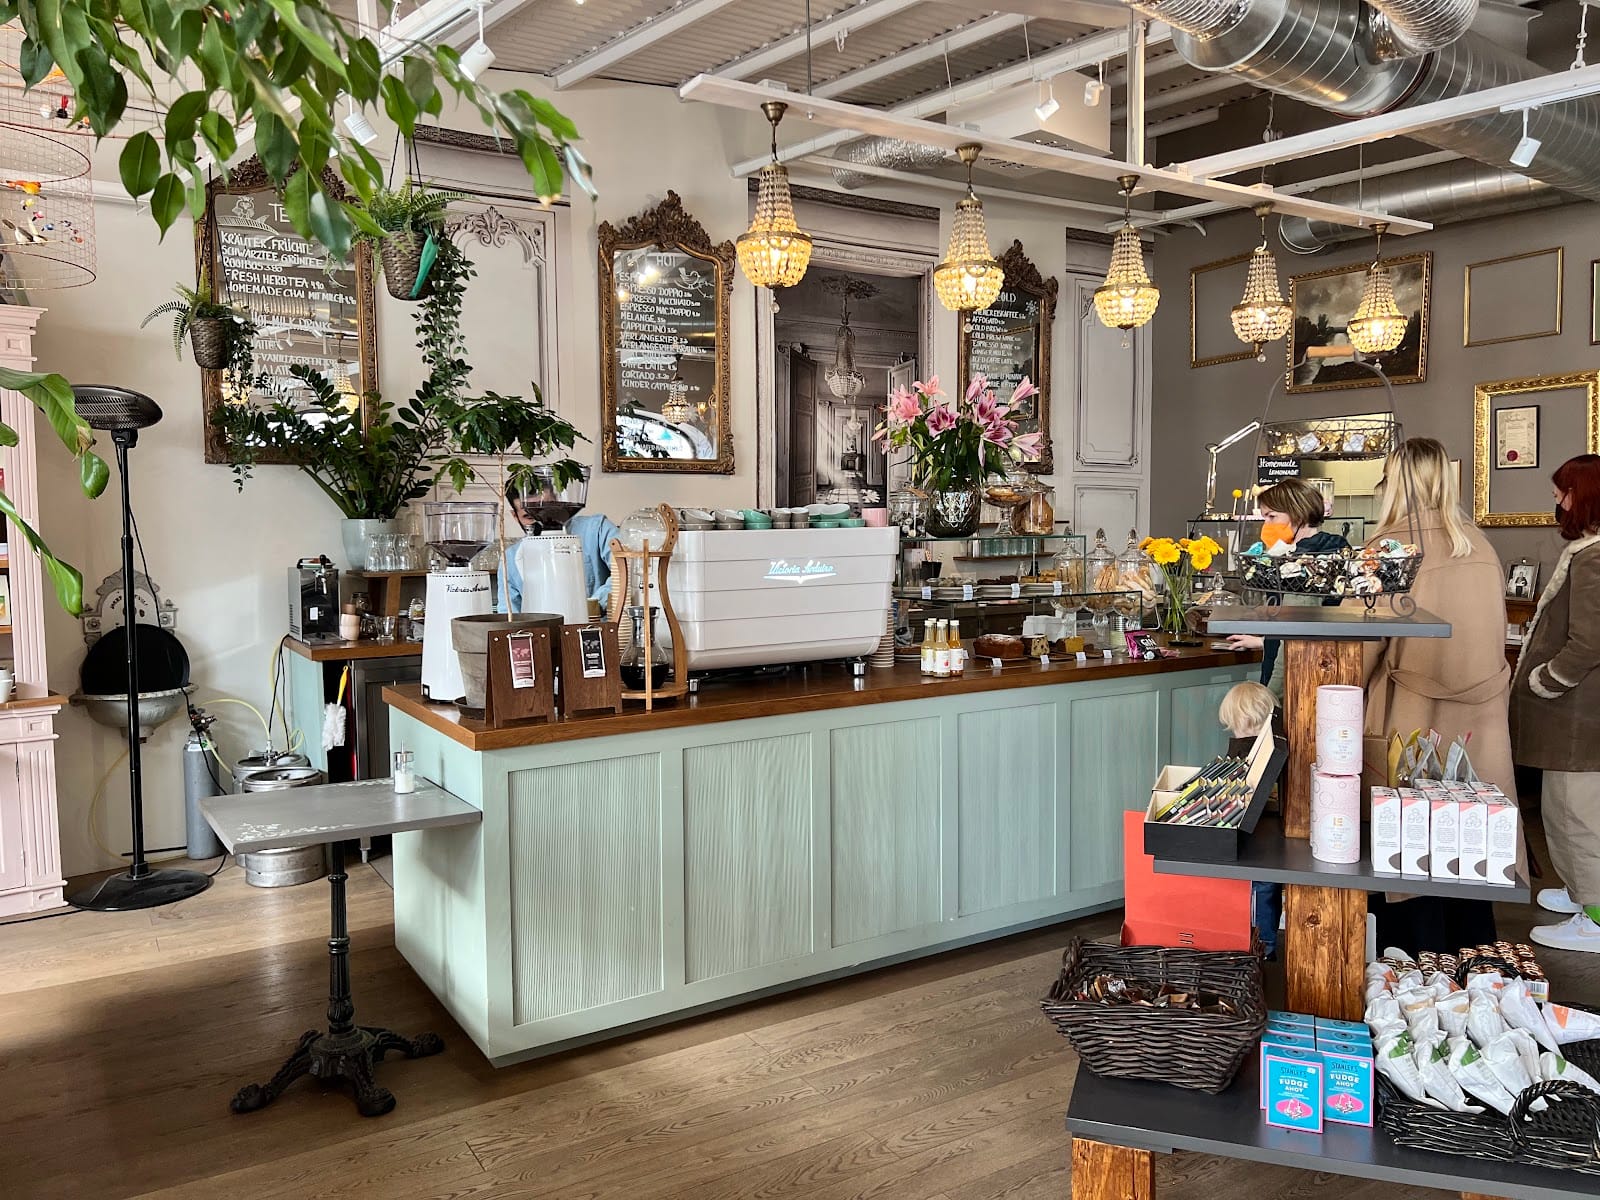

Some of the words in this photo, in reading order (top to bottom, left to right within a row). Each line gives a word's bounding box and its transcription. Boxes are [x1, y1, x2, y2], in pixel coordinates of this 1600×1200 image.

[268, 202, 291, 223] TE
[223, 256, 264, 270] ROOIBOS
[225, 269, 261, 283] FRESH
[225, 280, 283, 297] HOMEMADE
[620, 302, 656, 313] ESPRESSO
[620, 311, 656, 323] MELANGE
[621, 369, 655, 380] CORTADO
[621, 378, 650, 389] KINDER
[1258, 457, 1298, 468] Homemade
[1140, 638, 1157, 648] GIN
[1279, 1078, 1309, 1089] FUDGE
[1329, 1073, 1360, 1084] FUDGE
[1335, 1080, 1354, 1088] AHOY
[1284, 1085, 1304, 1093] AHOY
